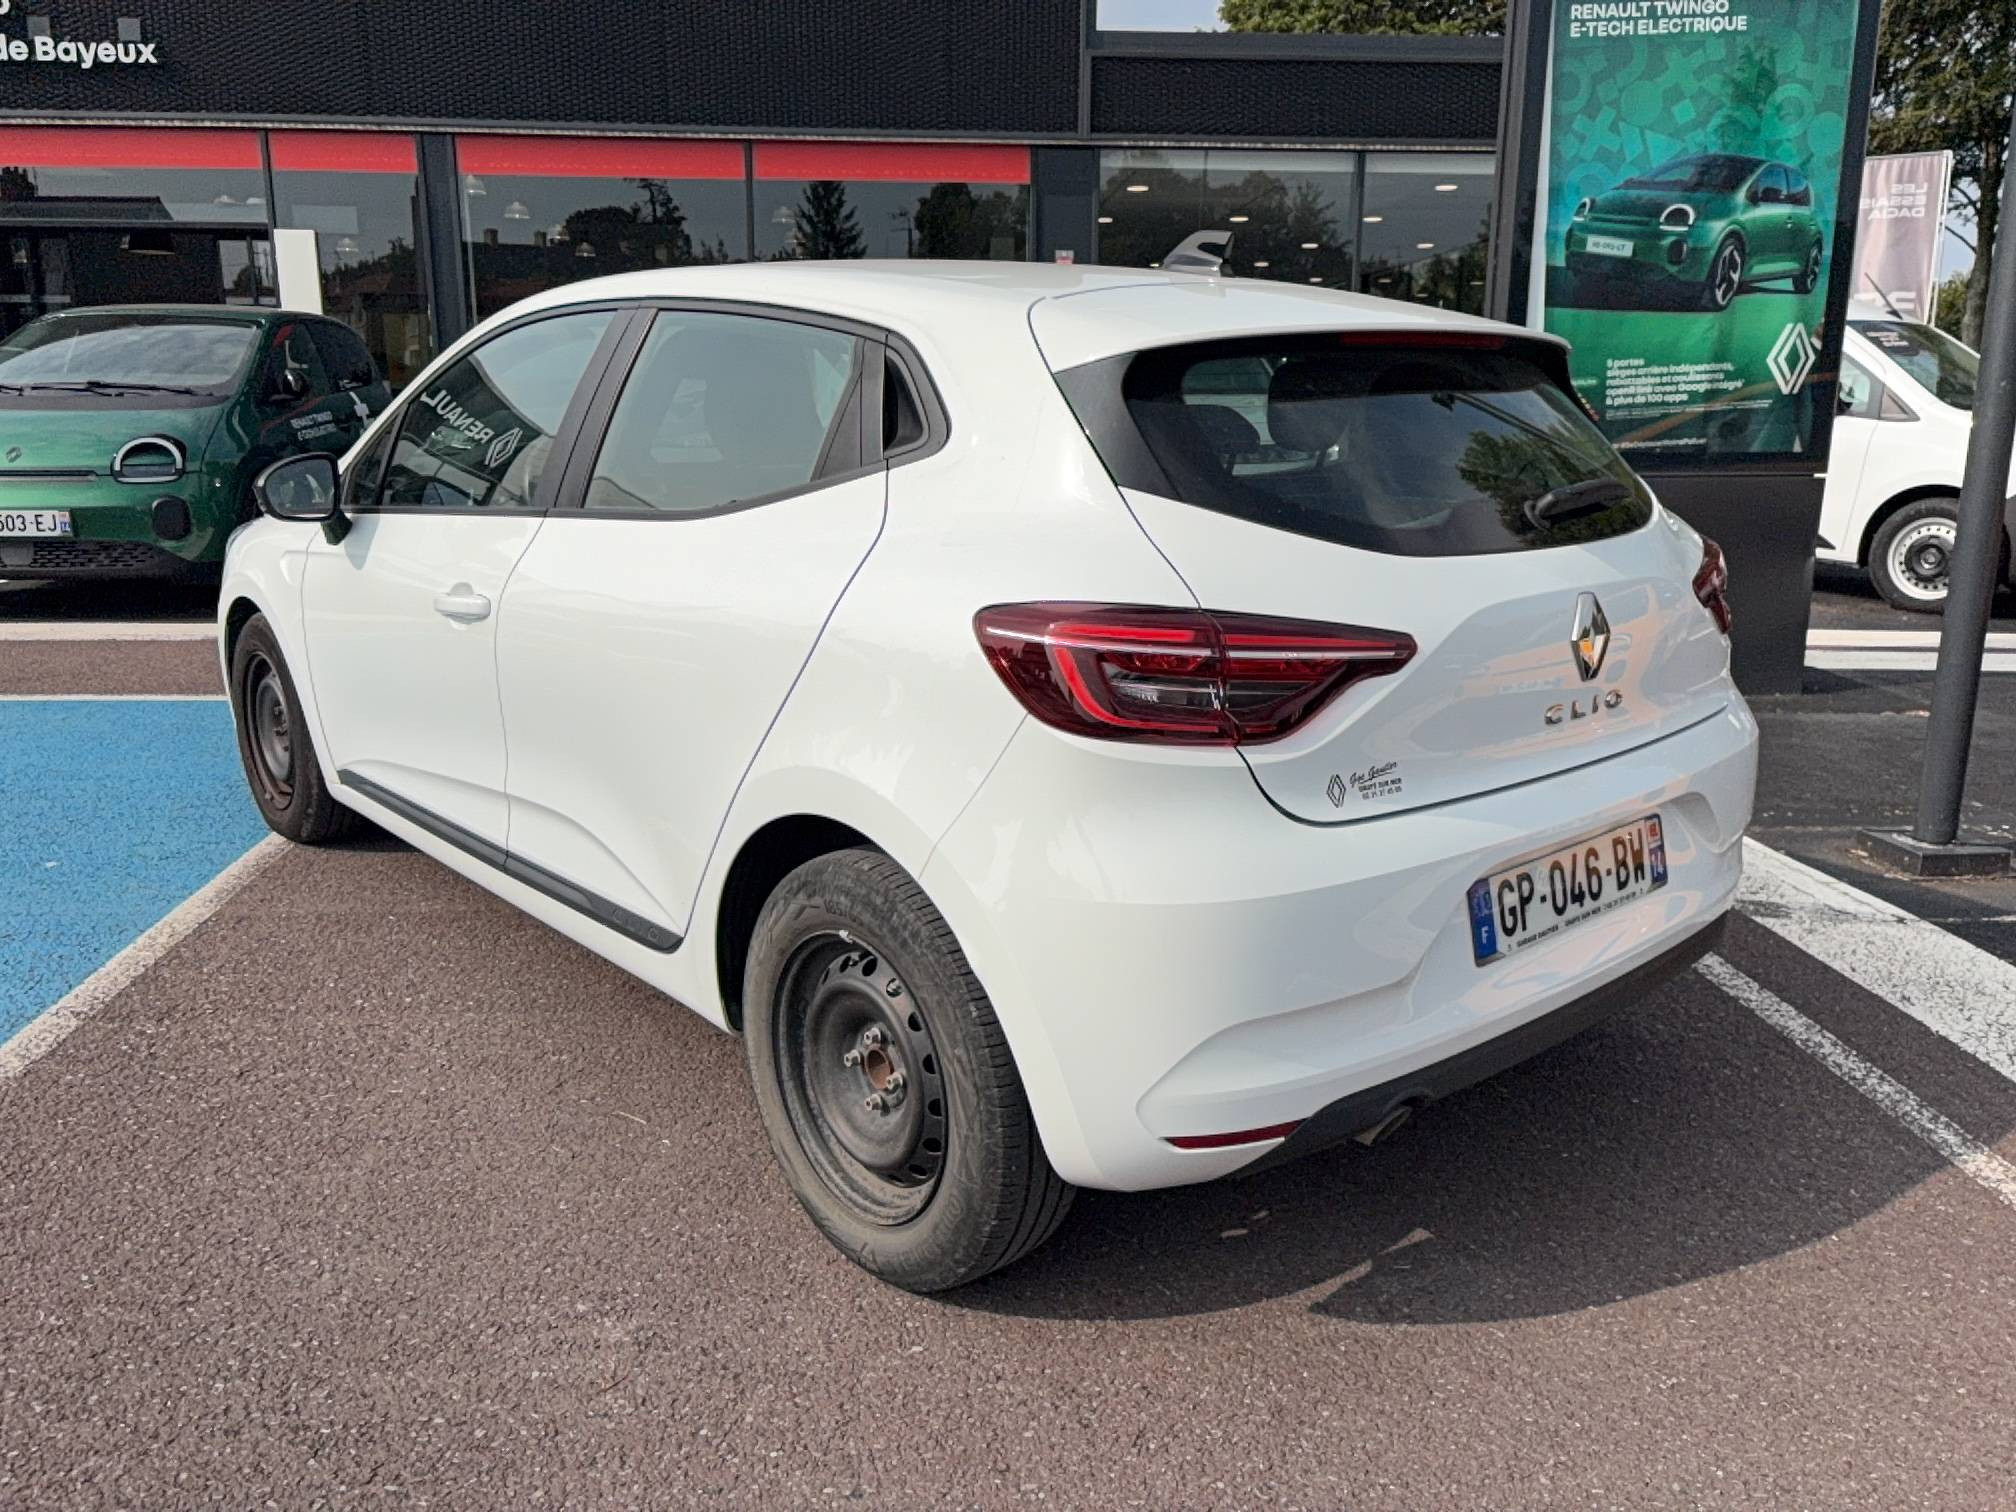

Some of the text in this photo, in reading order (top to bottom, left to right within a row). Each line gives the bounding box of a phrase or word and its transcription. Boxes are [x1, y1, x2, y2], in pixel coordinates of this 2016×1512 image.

[1571, 0, 1729, 20] RENAULT TWINGO
[1570, 16, 1748, 38] E-TECH ELECTRIQUE
[34, 36, 157, 69] Bayeux
[1544, 689, 1622, 725] CLIO
[1498, 828, 1645, 937] GP-046-BW
[1481, 926, 1489, 944] F
